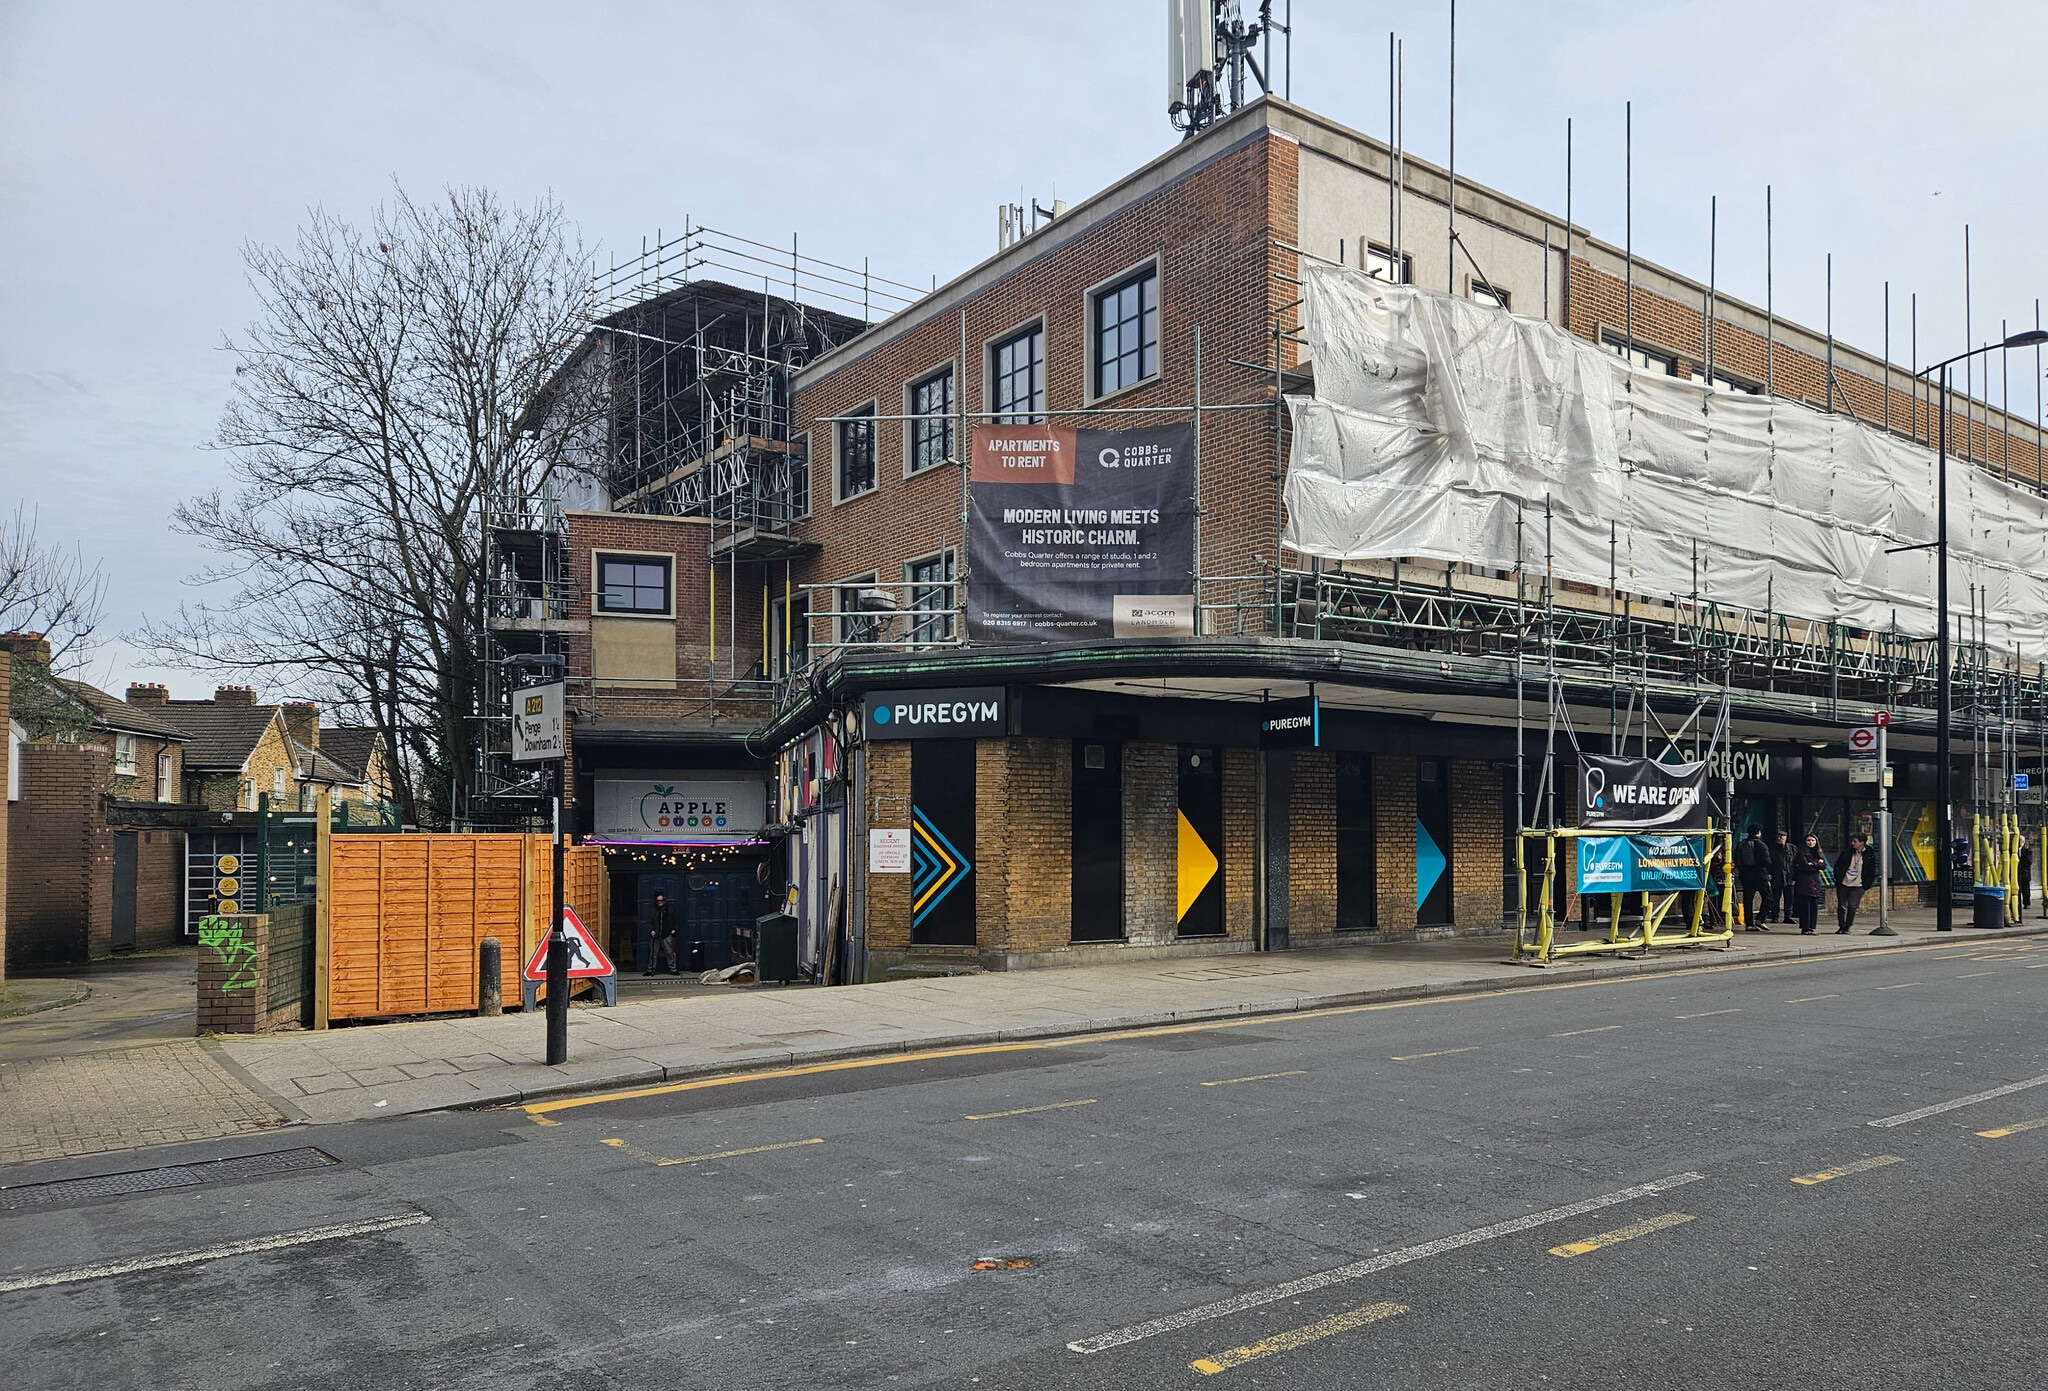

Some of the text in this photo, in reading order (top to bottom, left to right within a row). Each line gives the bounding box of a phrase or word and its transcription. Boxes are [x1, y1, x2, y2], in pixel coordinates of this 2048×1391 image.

[988, 439, 1060, 452] APARTMENTS
[1124, 444, 1158, 457] COBBS
[1002, 456, 1047, 468] TO RENT
[1124, 454, 1172, 468] QUARTER
[1003, 508, 1159, 525] MODERN LIVING MEETS
[1022, 529, 1140, 545] HISTORIC CHARM.
[1004, 550, 1027, 558] Cobbs
[1028, 551, 1054, 559] Quarter
[1055, 551, 1074, 560] offers
[1081, 553, 1100, 561] range
[1101, 552, 1109, 560] of
[1109, 552, 1132, 560] studio,
[1020, 560, 1050, 568] bedroom
[1051, 561, 1090, 569] apartments
[1090, 561, 1100, 569] for
[1101, 561, 1124, 570] private
[1034, 620, 1098, 628] cobbs-quarter.co.uk
[894, 701, 998, 724] PUREGYM
[1270, 715, 1311, 731] PUREGYM
[1877, 713, 1886, 725] F
[525, 721, 541, 736] Penge
[525, 737, 552, 751] Downham
[1612, 784, 1700, 806] WE ARE OPEN
[658, 802, 726, 814] APPLE
[1648, 845, 1688, 855] NO CONTRACT
[1594, 861, 1623, 870] PUREGYM
[1638, 857, 1700, 868] LOW MONTHLY PRICES
[1641, 870, 1698, 881] UNLIMITED CLASSES
[1953, 870, 1973, 879] FREE
